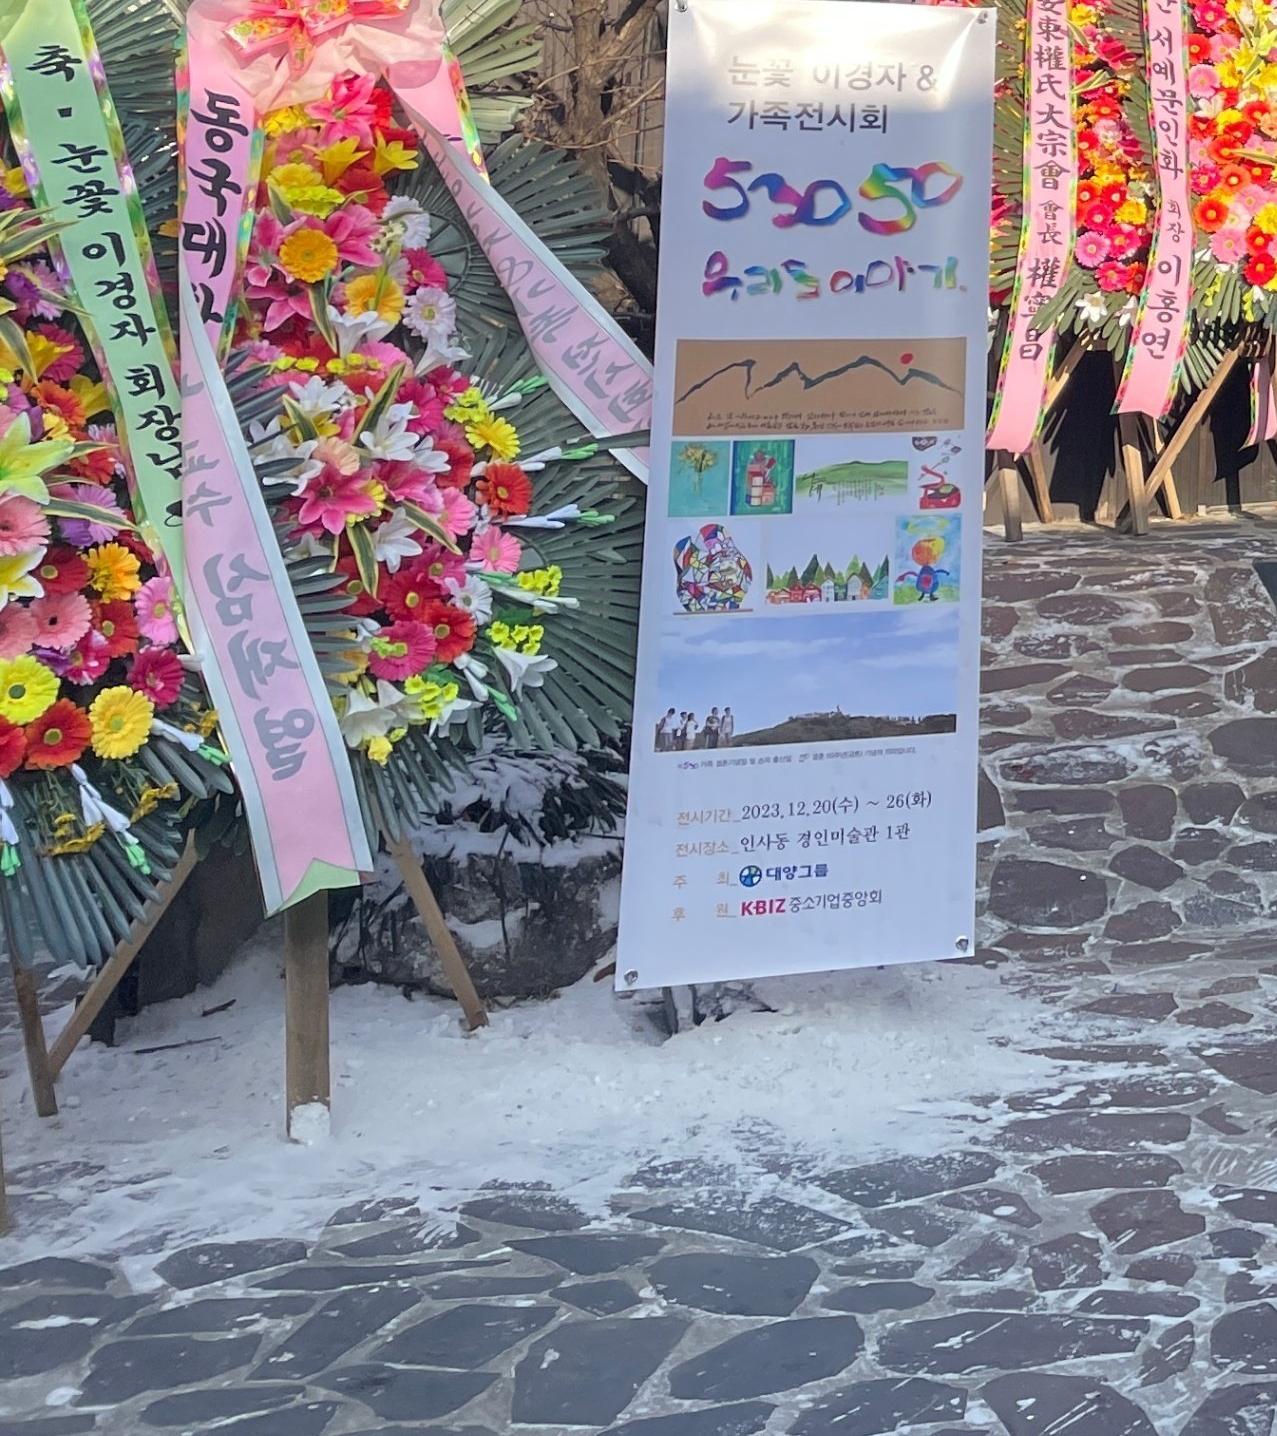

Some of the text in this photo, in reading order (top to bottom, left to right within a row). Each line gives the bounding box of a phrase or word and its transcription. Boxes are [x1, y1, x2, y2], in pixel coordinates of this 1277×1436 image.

[728, 55, 938, 93] 눈꽃 이경자 &
[727, 99, 888, 134] 가족전시회
[51, 143, 120, 219] 눈꽃
[1166, 200, 1186, 244] 회장
[82, 231, 157, 347] 이경자
[1141, 255, 1182, 360] 이홍연
[886, 790, 932, 810] 26(화)
[740, 832, 790, 853] 인사동
[797, 825, 879, 849] 경인미술관
[886, 822, 911, 841] 1관
[765, 863, 829, 882] 대양그룹
[789, 889, 882, 914] 중소기업중앙회
